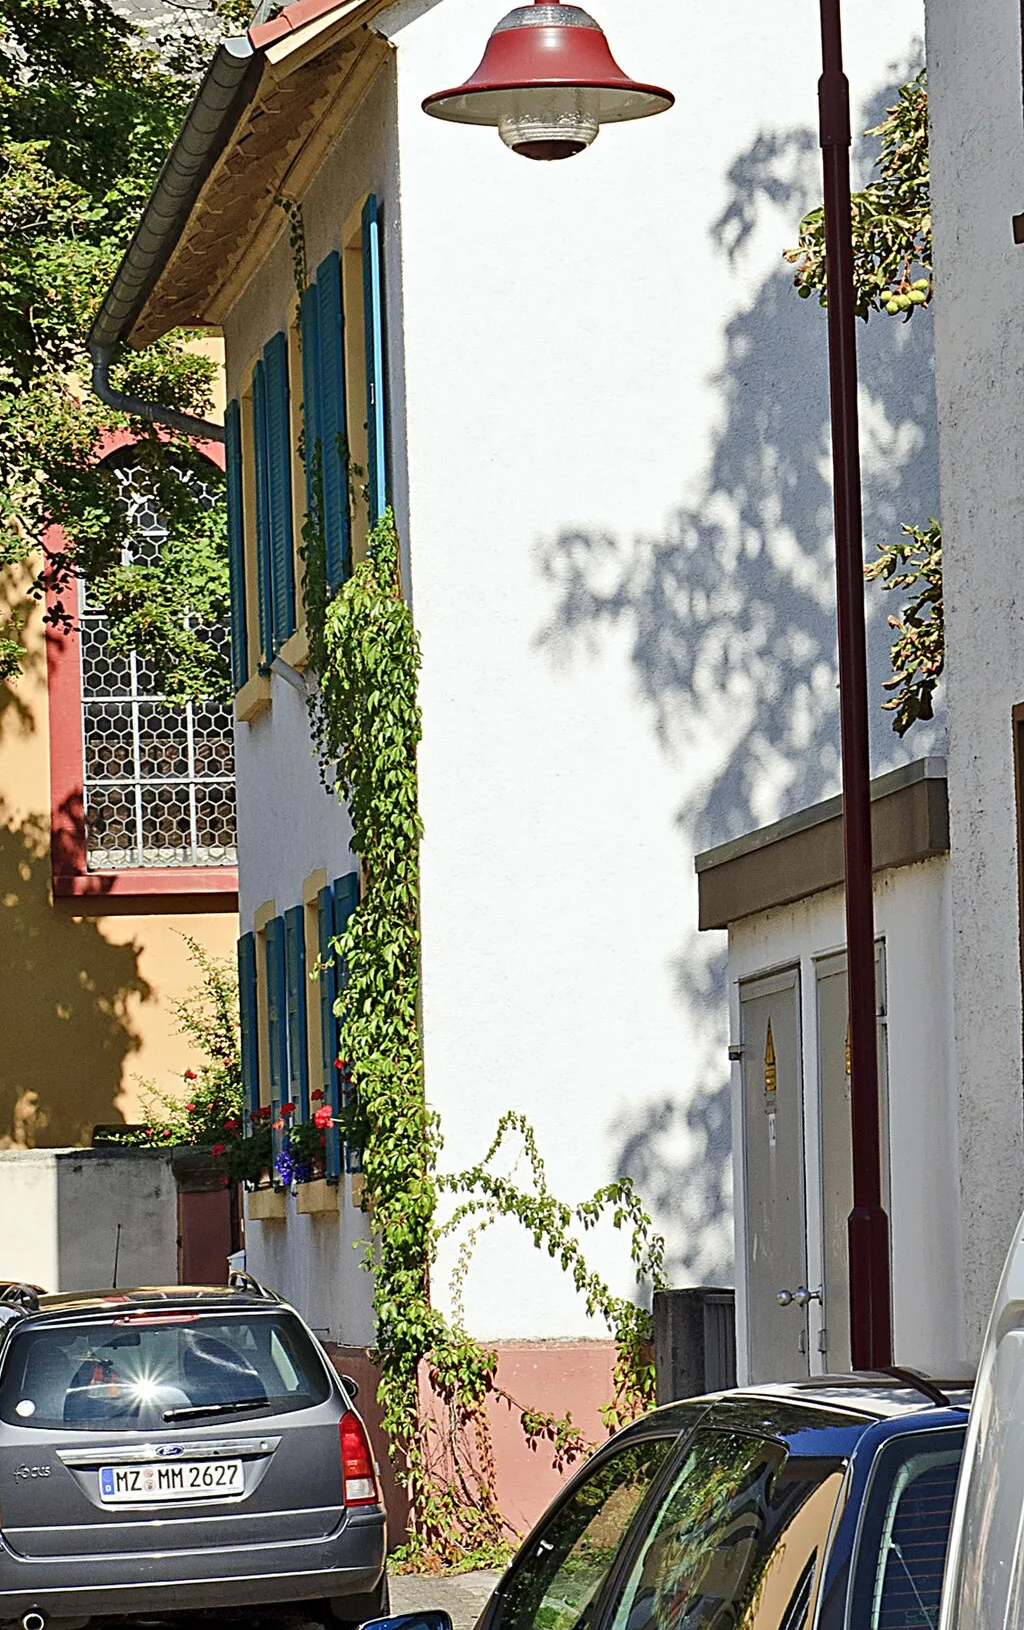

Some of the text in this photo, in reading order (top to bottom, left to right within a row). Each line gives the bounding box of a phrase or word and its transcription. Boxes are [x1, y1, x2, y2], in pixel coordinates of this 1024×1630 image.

[116, 1465, 238, 1492] MZ MM 2627
